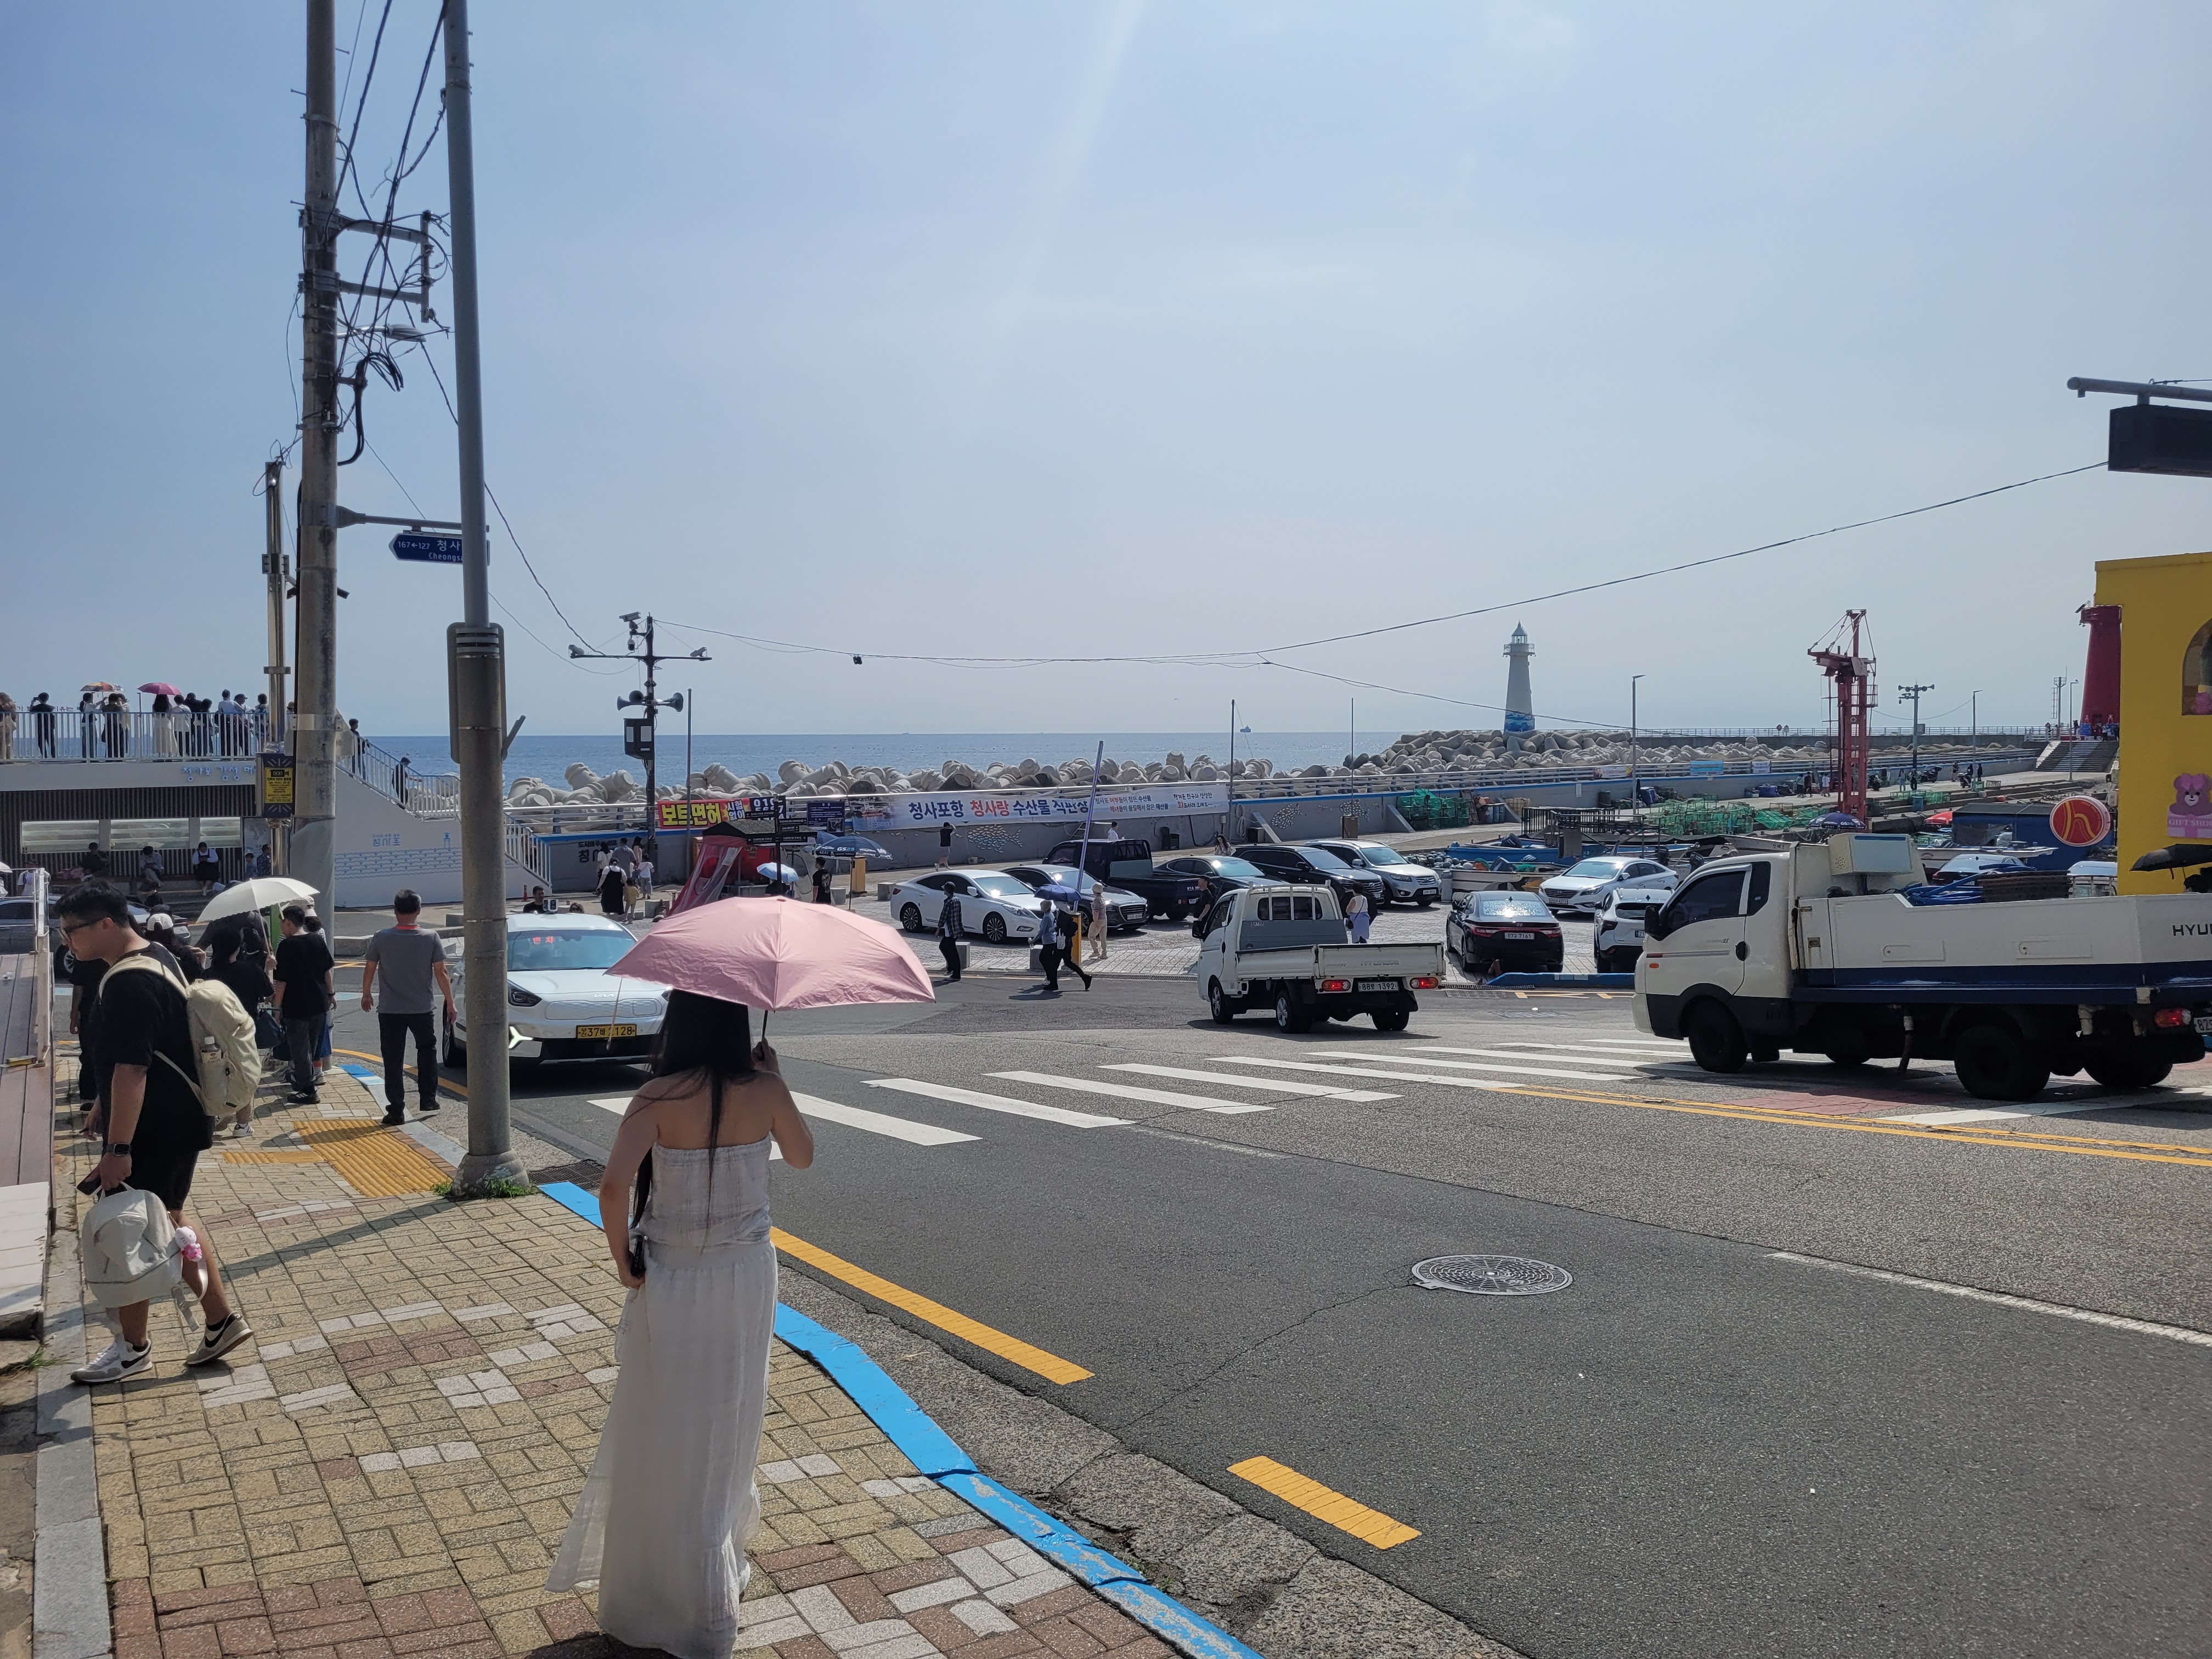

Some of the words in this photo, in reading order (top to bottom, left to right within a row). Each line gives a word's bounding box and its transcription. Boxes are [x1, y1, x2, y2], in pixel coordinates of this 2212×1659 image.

[727, 799, 743, 811] 시험
[908, 799, 964, 820] 청사포항
[969, 799, 1010, 817] 청사랑
[1012, 799, 1051, 816] 수산물
[661, 803, 722, 826] 보트면허
[729, 809, 745, 821] 없이
[2172, 923, 2212, 936] HYU
